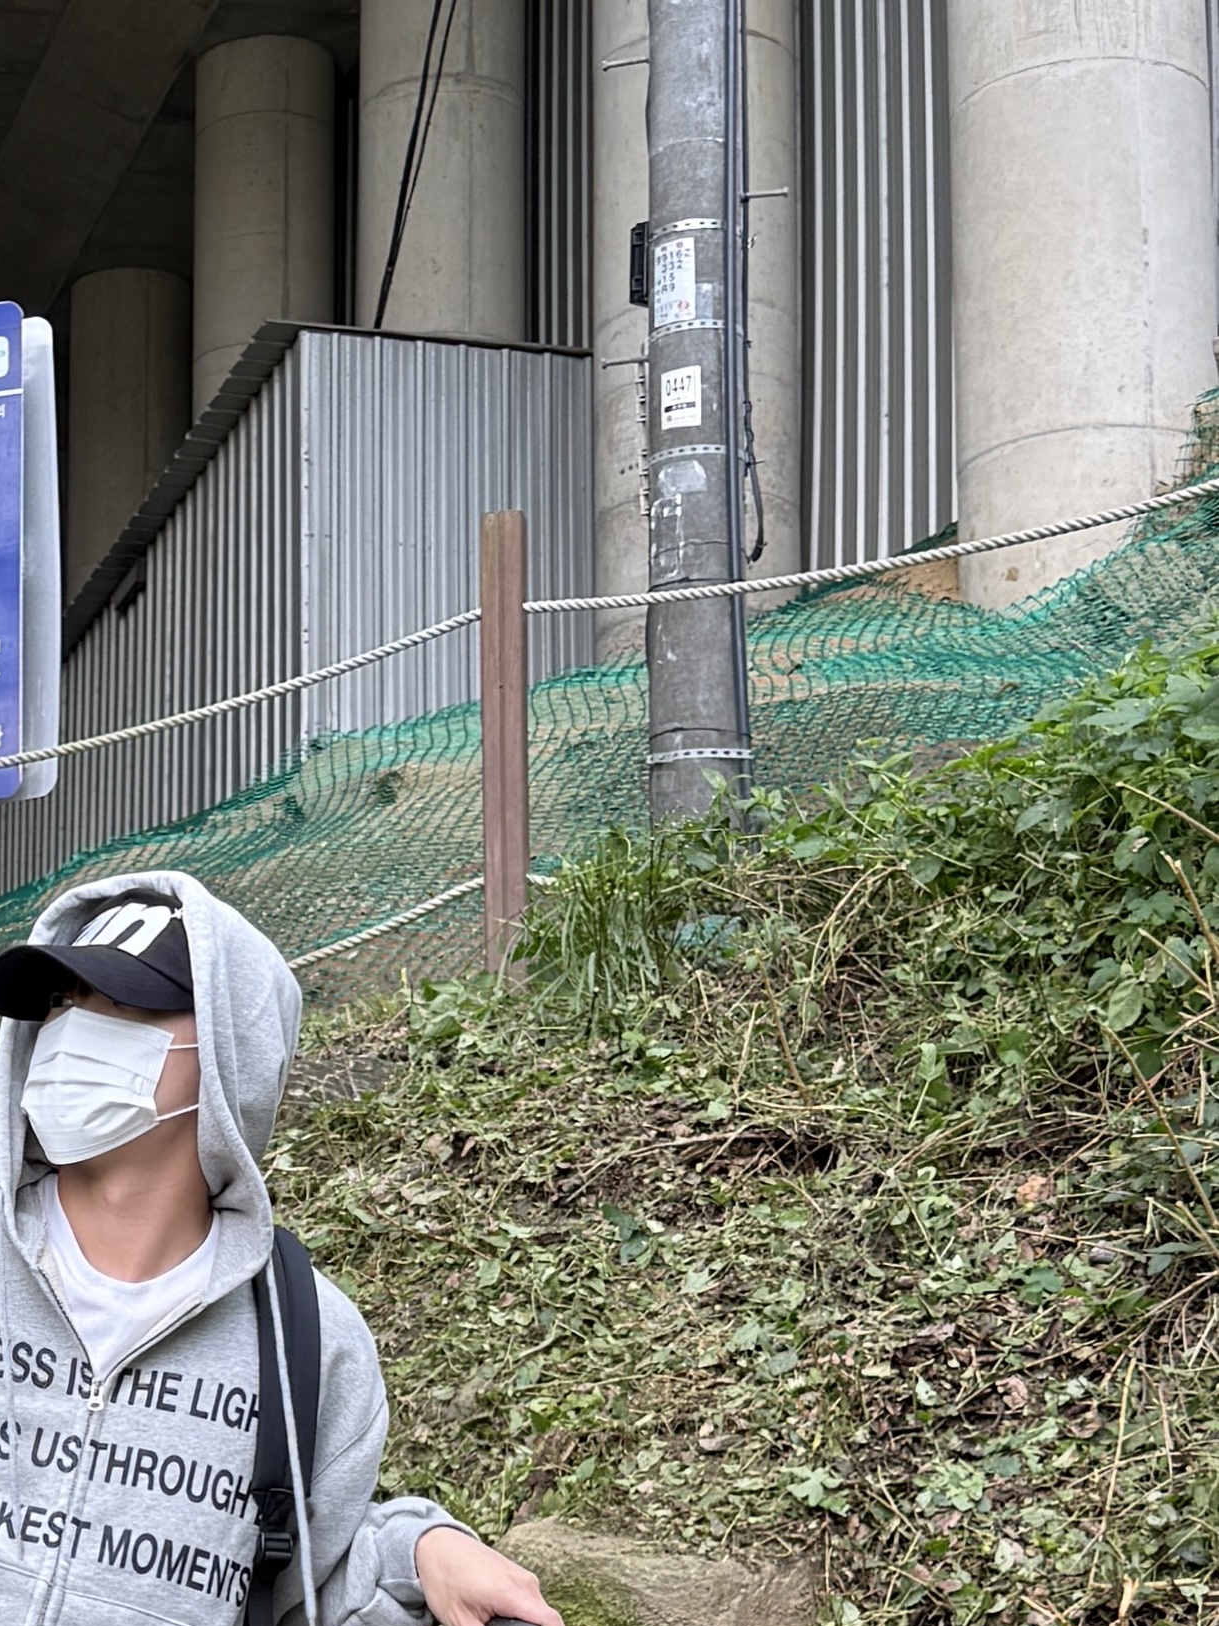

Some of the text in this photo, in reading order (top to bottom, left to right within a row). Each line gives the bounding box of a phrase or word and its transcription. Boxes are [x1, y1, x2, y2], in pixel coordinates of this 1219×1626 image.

[66, 1357, 94, 1399] IS
[110, 1367, 183, 1412] THE
[31, 1427, 82, 1473] US
[88, 1438, 253, 1519] THROUGH
[97, 1524, 252, 1608] MOMENTS
